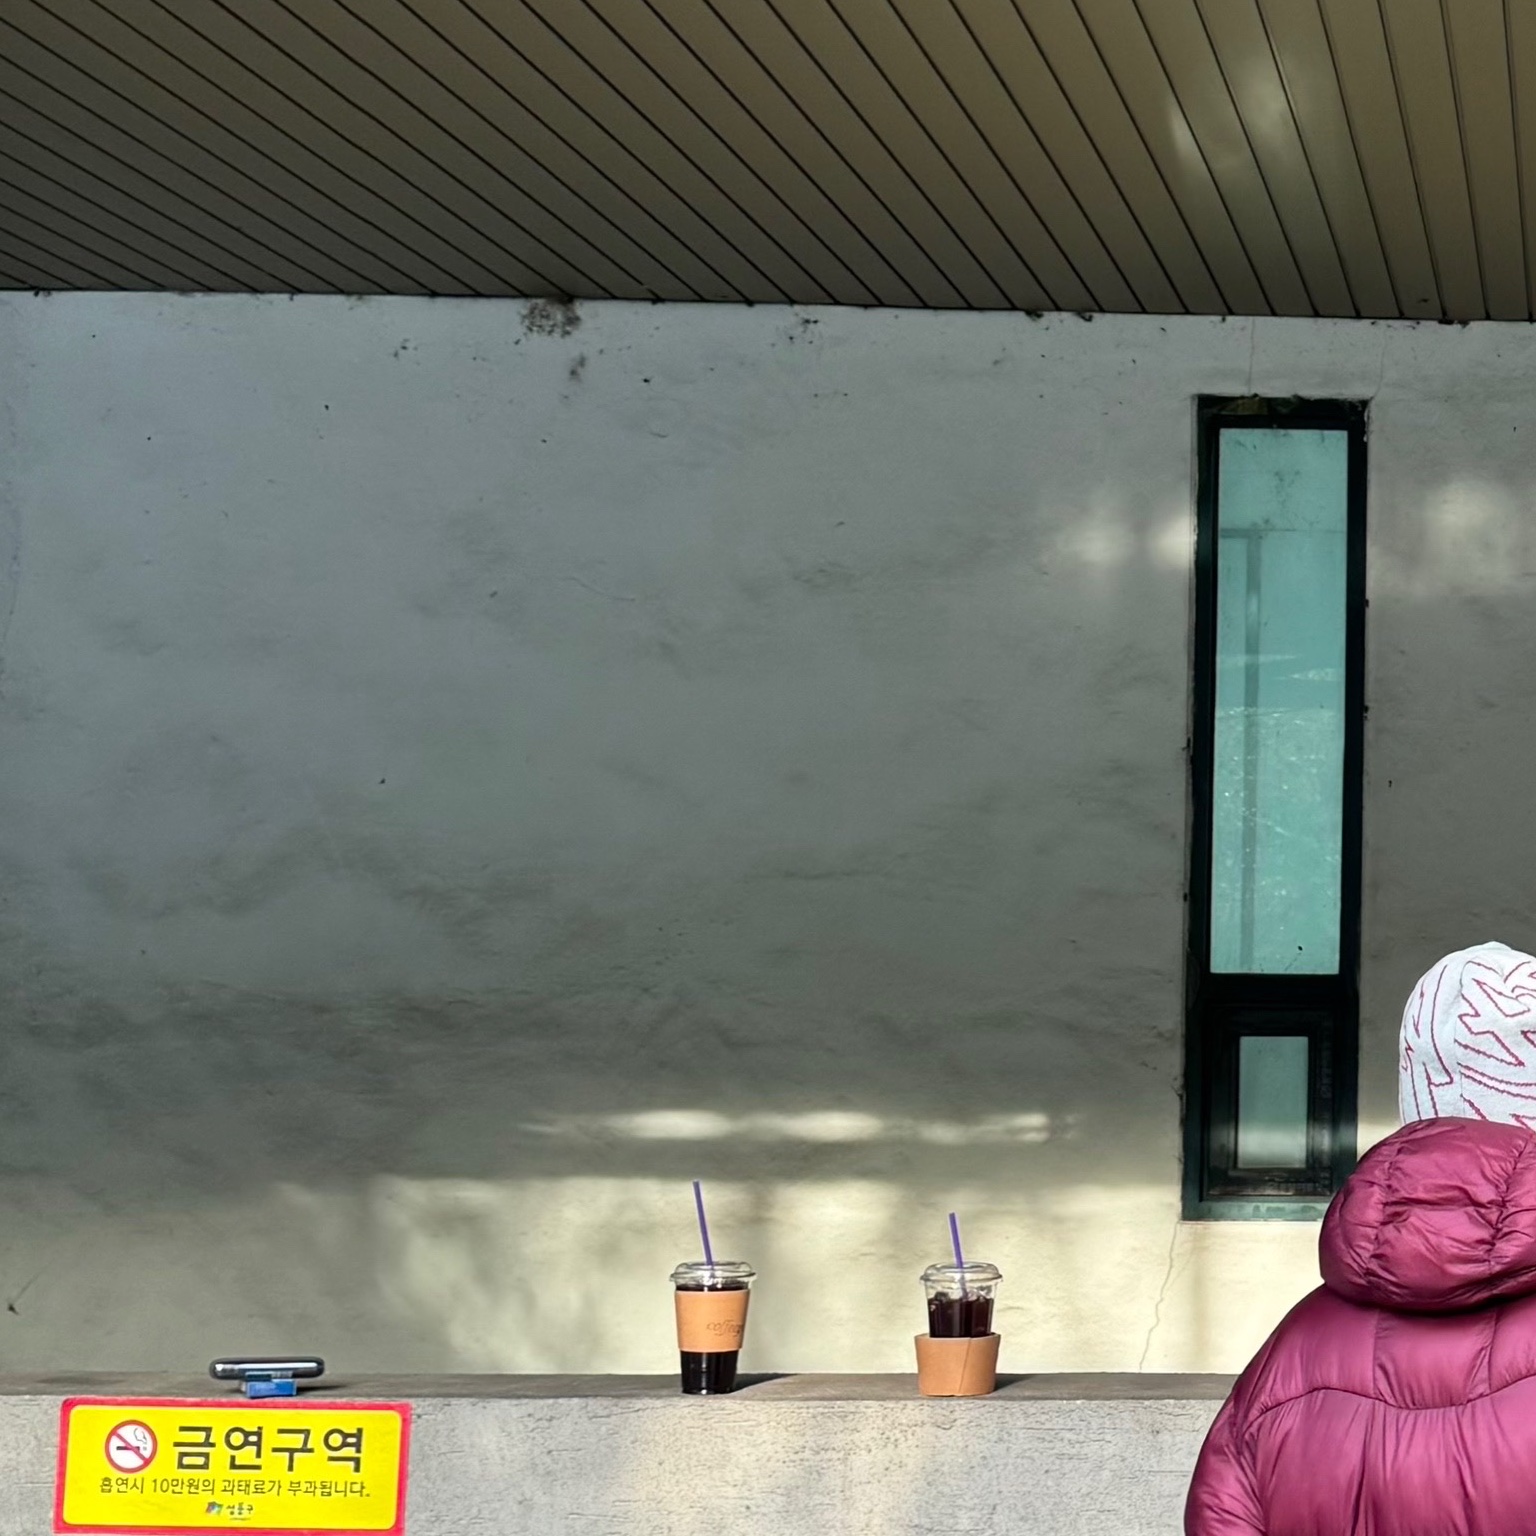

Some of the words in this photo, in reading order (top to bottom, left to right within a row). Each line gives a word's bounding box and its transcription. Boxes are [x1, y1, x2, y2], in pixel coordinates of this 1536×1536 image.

[172, 1425, 364, 1473] 금연구역
[100, 1477, 145, 1494] 흡연시
[152, 1478, 216, 1495] 10만원의
[220, 1480, 282, 1496] 과태료가
[287, 1482, 371, 1498] 부과됩니다.
